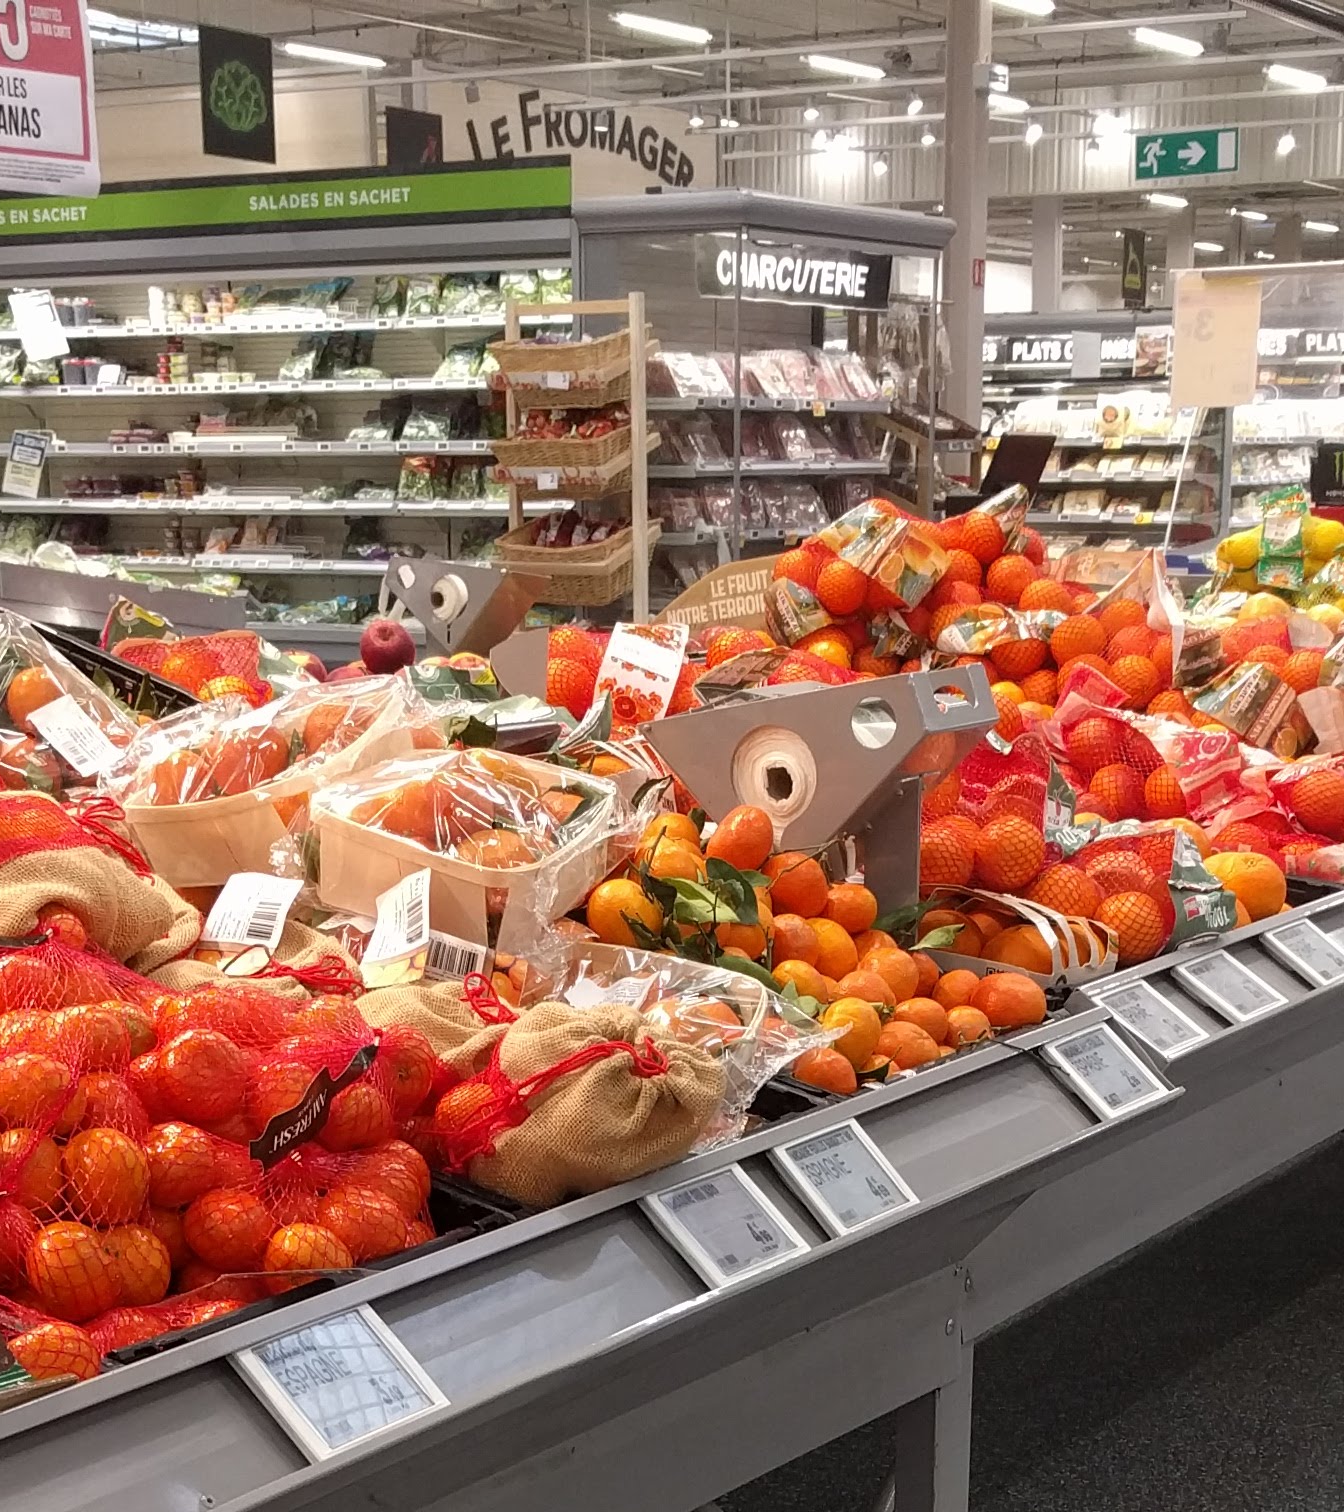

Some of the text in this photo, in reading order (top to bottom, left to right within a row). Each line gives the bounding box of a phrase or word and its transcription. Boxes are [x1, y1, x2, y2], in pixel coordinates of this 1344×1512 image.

[7, 76, 28, 99] LES
[518, 89, 694, 188] FROMAGER
[249, 186, 411, 212] SALADES EN SACHET
[9, 208, 29, 224] EN
[33, 206, 87, 223] SACHET
[716, 249, 870, 298] CHARCUTERIE
[1011, 336, 1062, 362] PLATS
[710, 569, 768, 598] LE FRUIT
[666, 605, 709, 625] NOTRE
[270, 1108, 314, 1155] FRESH
[275, 1350, 353, 1398] ESPAGNE
